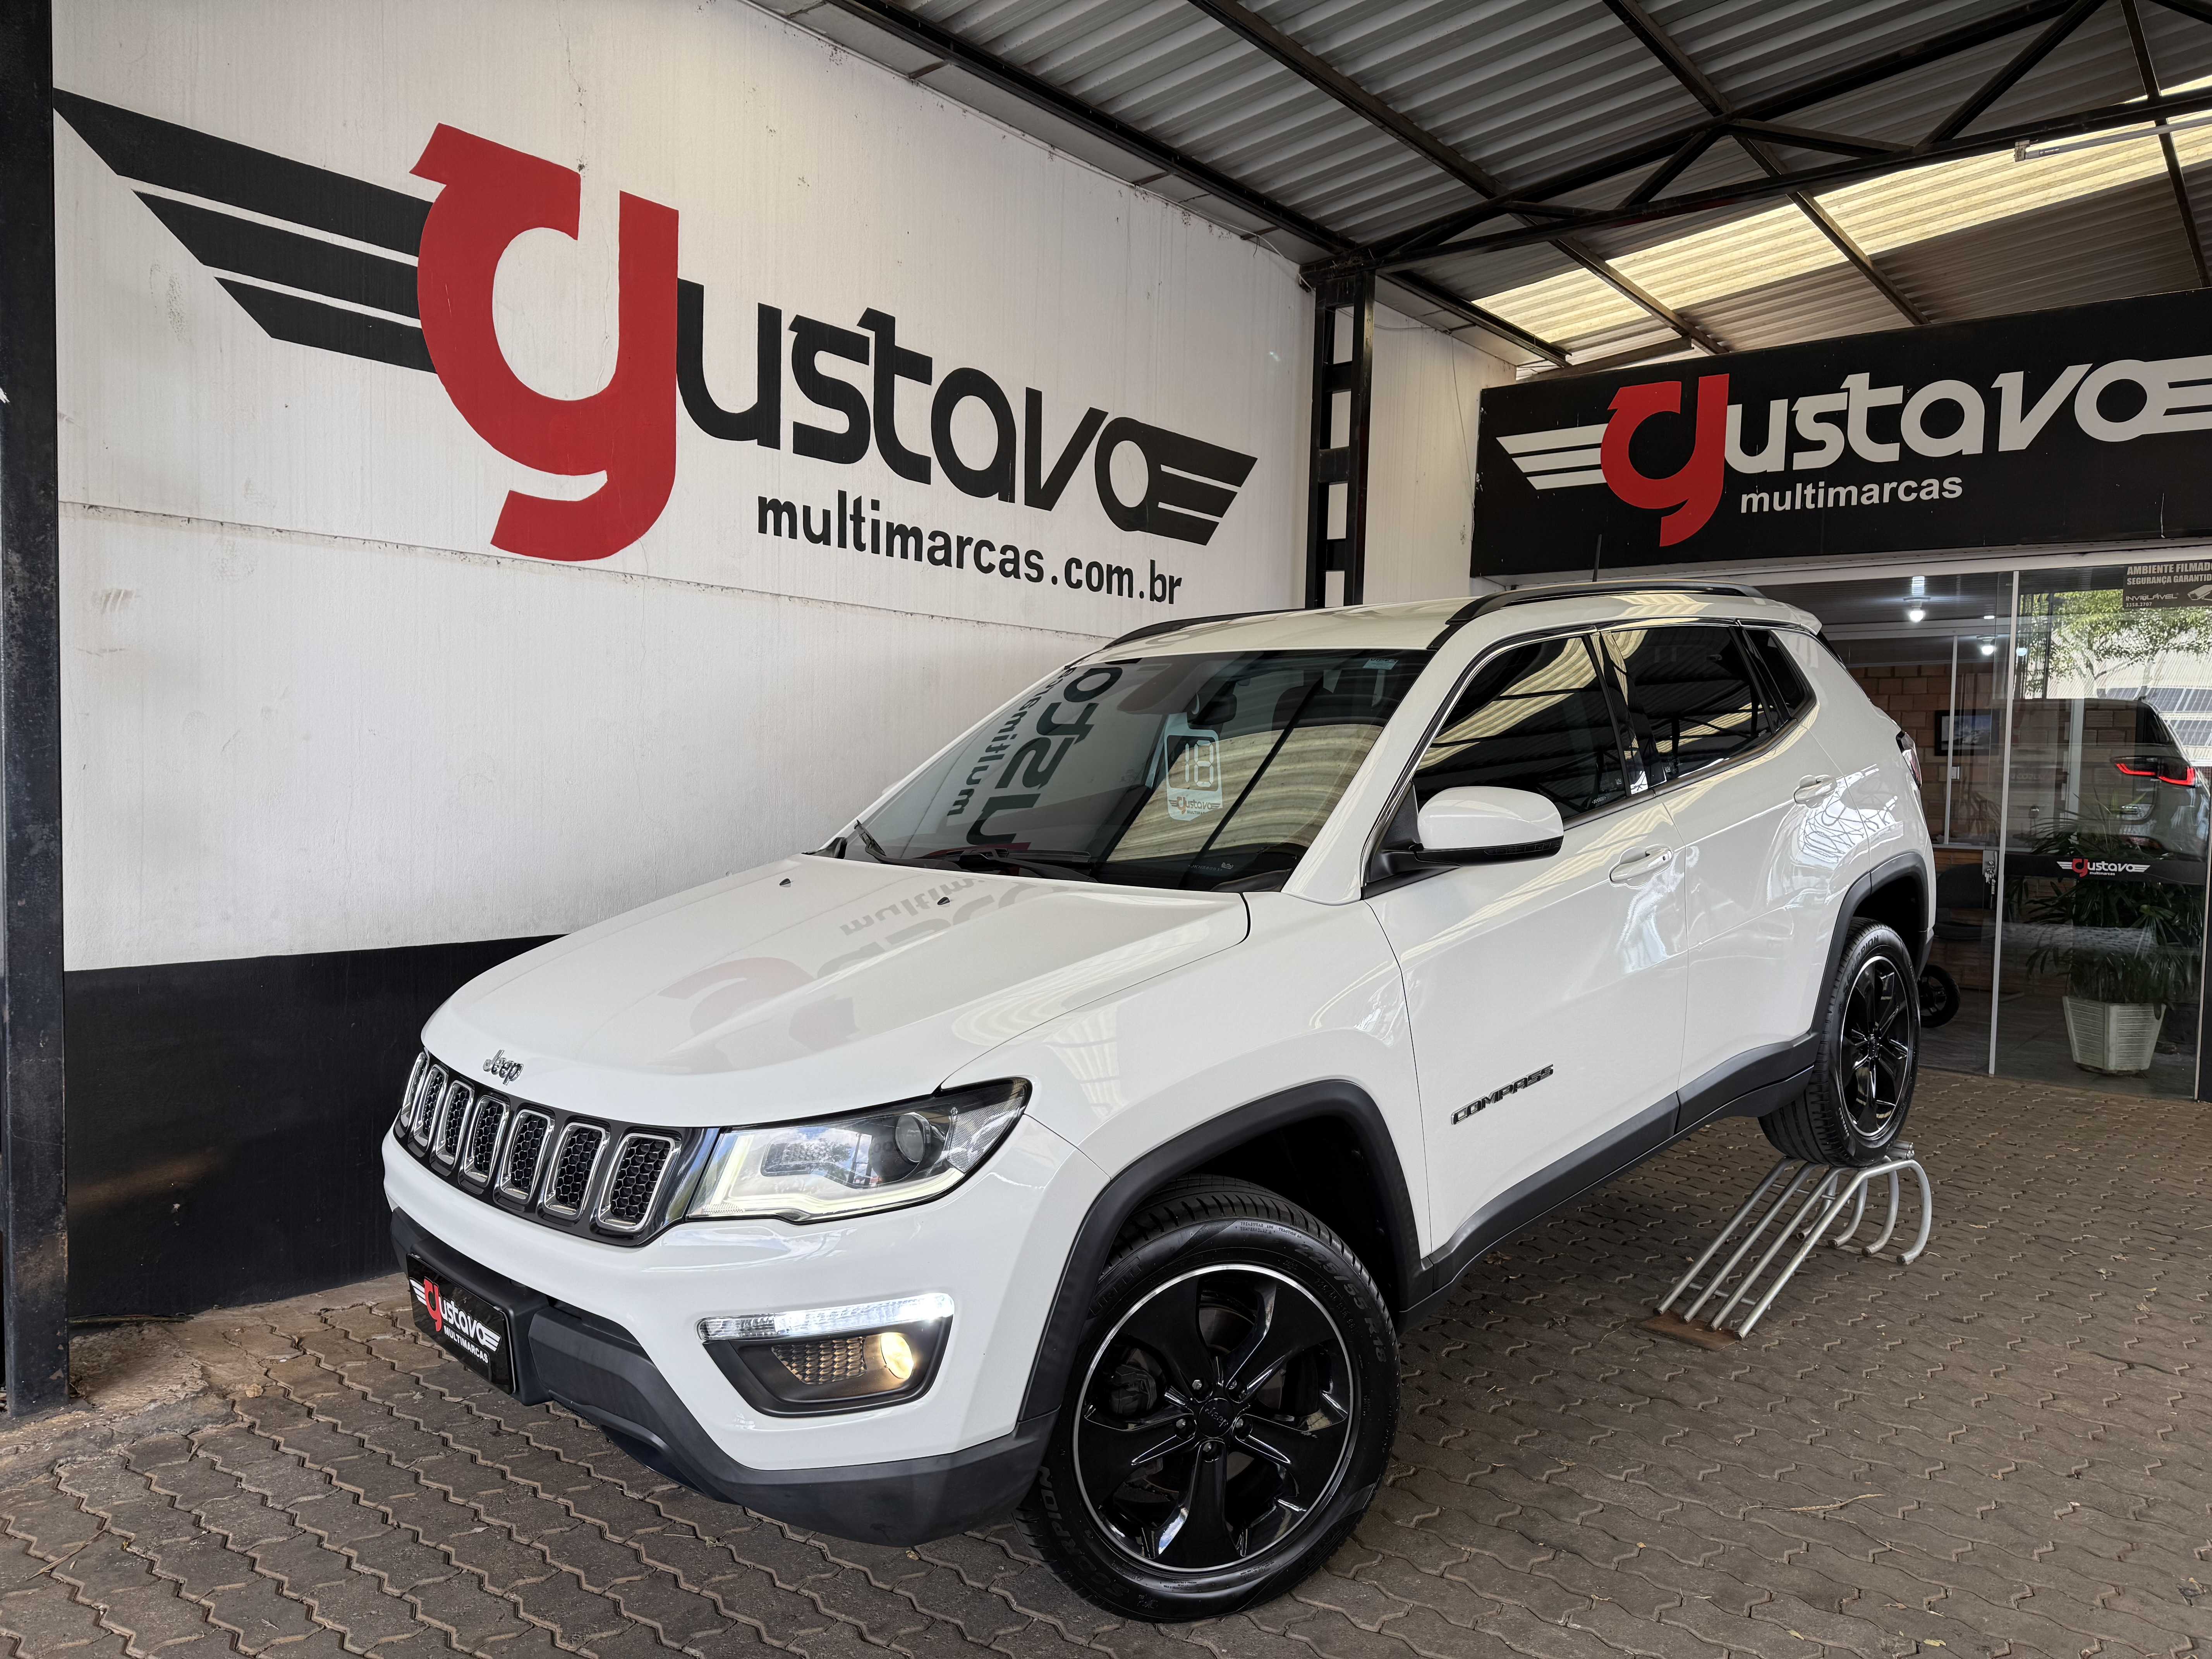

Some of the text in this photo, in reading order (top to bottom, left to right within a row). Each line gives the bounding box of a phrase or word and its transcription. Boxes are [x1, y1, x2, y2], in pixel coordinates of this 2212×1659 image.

[409, 122, 1162, 562] gustavo
[1600, 359, 2161, 547] gustavo
[1741, 473, 1963, 514] multimarcas
[757, 489, 1182, 605] multimarcas.com.br
[2127, 562, 2212, 575] AMBIENTE FILMAD
[2127, 574, 2212, 585] SEGURANÇA GARANTID
[1185, 740, 1214, 787] 18
[2072, 858, 2134, 878] gustavo
[483, 1049, 524, 1086] Jeep
[1450, 1063, 1554, 1125] COMPASS
[1295, 1244, 1369, 1310] 225/55
[424, 1276, 487, 1346] gustavo
[444, 1325, 489, 1364] MULTIMARCAS
